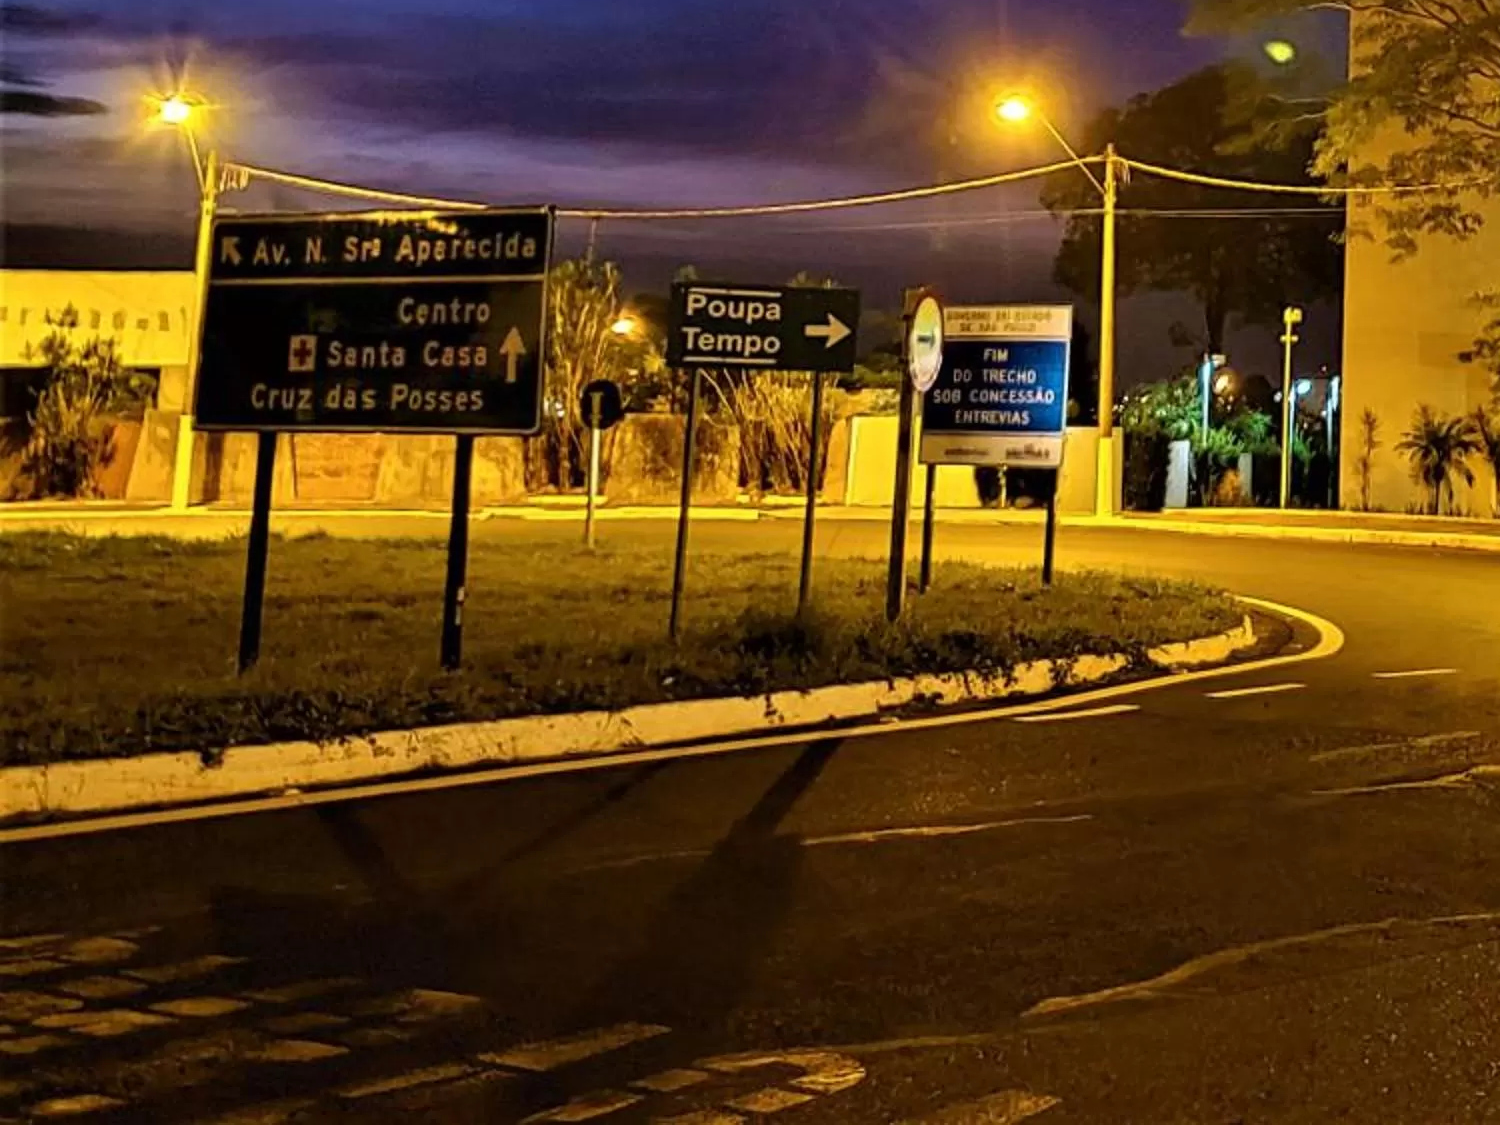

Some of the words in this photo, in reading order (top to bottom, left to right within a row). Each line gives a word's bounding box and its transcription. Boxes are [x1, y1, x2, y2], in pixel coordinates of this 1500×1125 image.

[253, 238, 292, 266] Av.
[305, 237, 327, 264] N.
[395, 232, 537, 268] Aparecida
[398, 296, 491, 324] Centro
[685, 293, 782, 325] Poupa
[326, 339, 406, 367] Santa
[423, 340, 488, 366] Casa
[681, 326, 782, 356] Tempo
[983, 348, 1009, 362] FIM
[953, 368, 973, 382] DO
[983, 368, 1037, 384] TRECHO
[251, 382, 313, 410] Cruz
[325, 384, 376, 410] das
[391, 383, 484, 412] Posses
[933, 389, 962, 404] SOB
[969, 385, 1055, 404] CONCESSÃO
[955, 409, 1030, 426] ENTREVIAS
